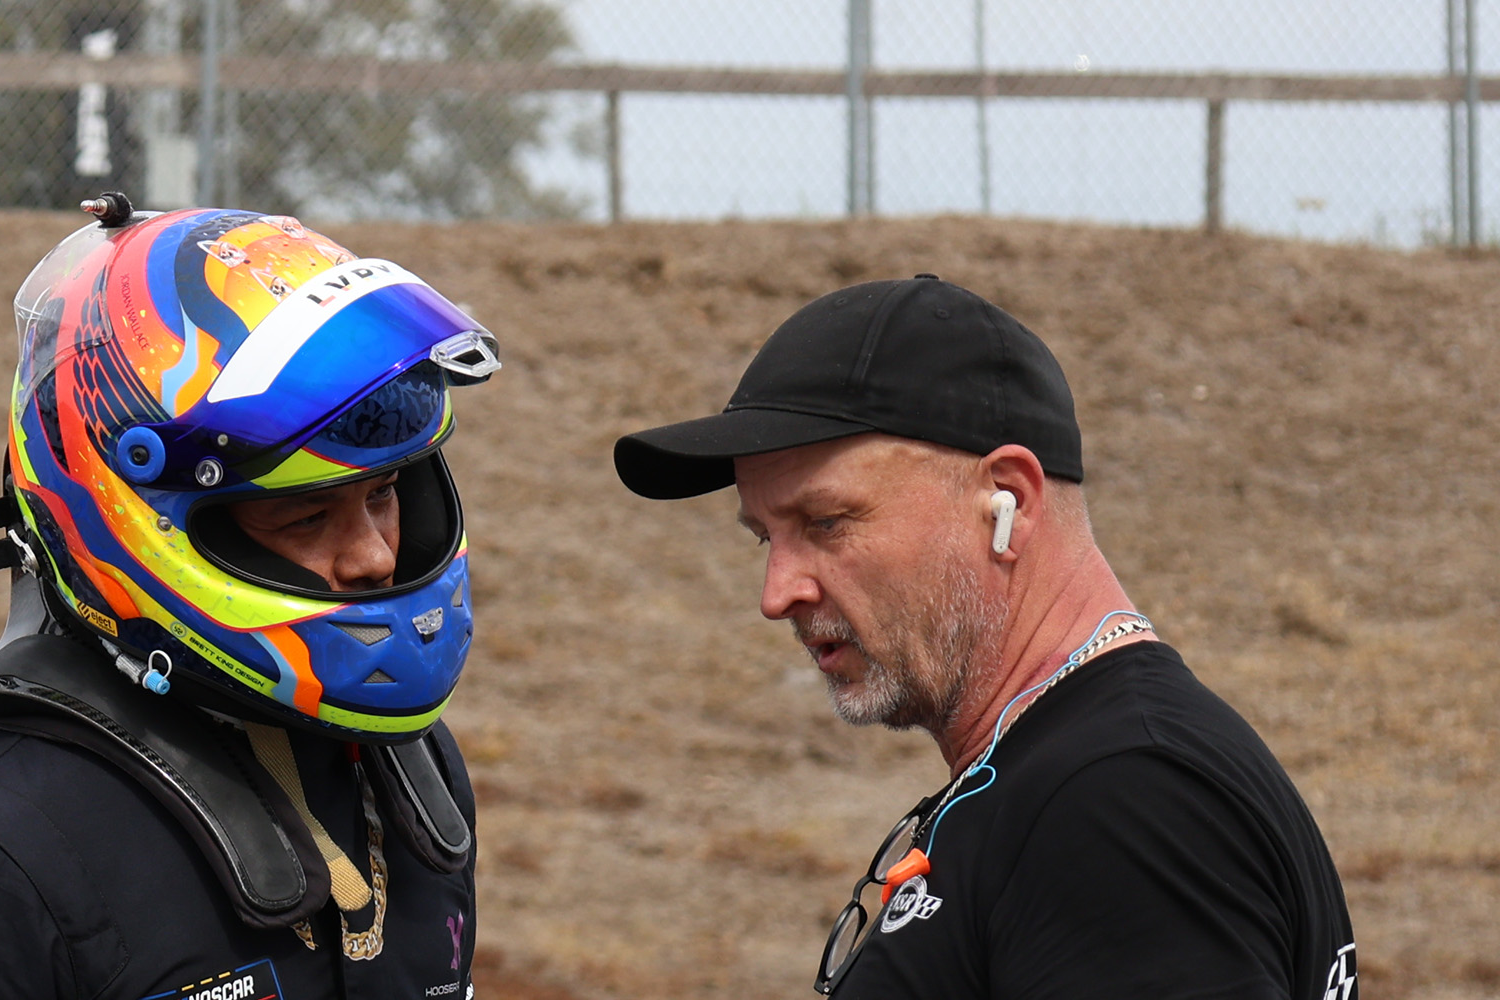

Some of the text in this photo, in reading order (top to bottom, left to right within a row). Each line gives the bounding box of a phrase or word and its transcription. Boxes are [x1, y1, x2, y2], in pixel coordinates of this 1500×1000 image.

[126, 308, 150, 351] WALLACE
[215, 655, 236, 671] KING
[234, 667, 265, 688] DESIGN
